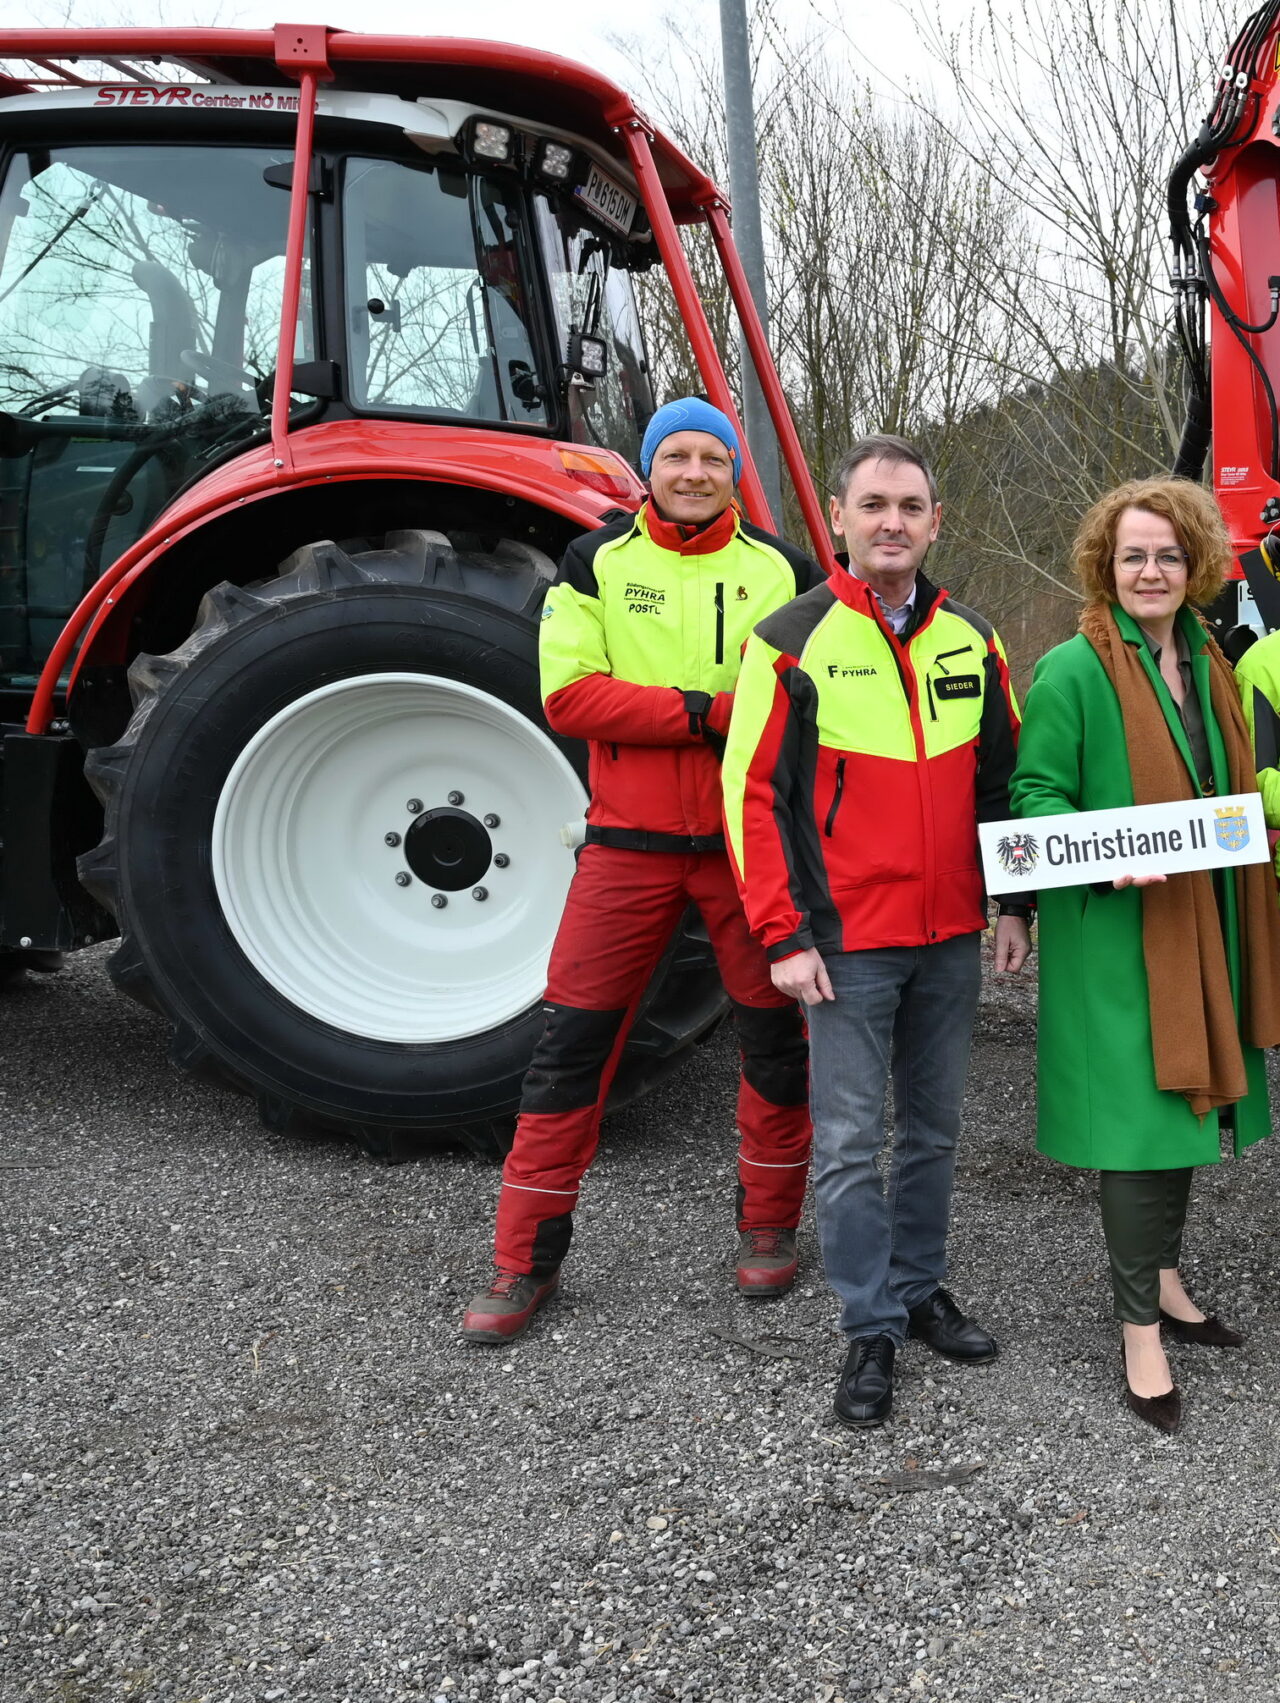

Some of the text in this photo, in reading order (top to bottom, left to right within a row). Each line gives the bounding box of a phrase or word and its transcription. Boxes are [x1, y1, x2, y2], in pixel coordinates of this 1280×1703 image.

[94, 86, 192, 106] STEYR
[192, 92, 247, 108] Center
[249, 92, 274, 109] NÖ
[587, 172, 598, 197] P
[625, 588, 665, 601] PYHRA
[628, 603, 661, 615] POSTL
[842, 668, 877, 678] PYHRA
[945, 681, 974, 691] SIEDER
[1045, 827, 1183, 866] Christiane
